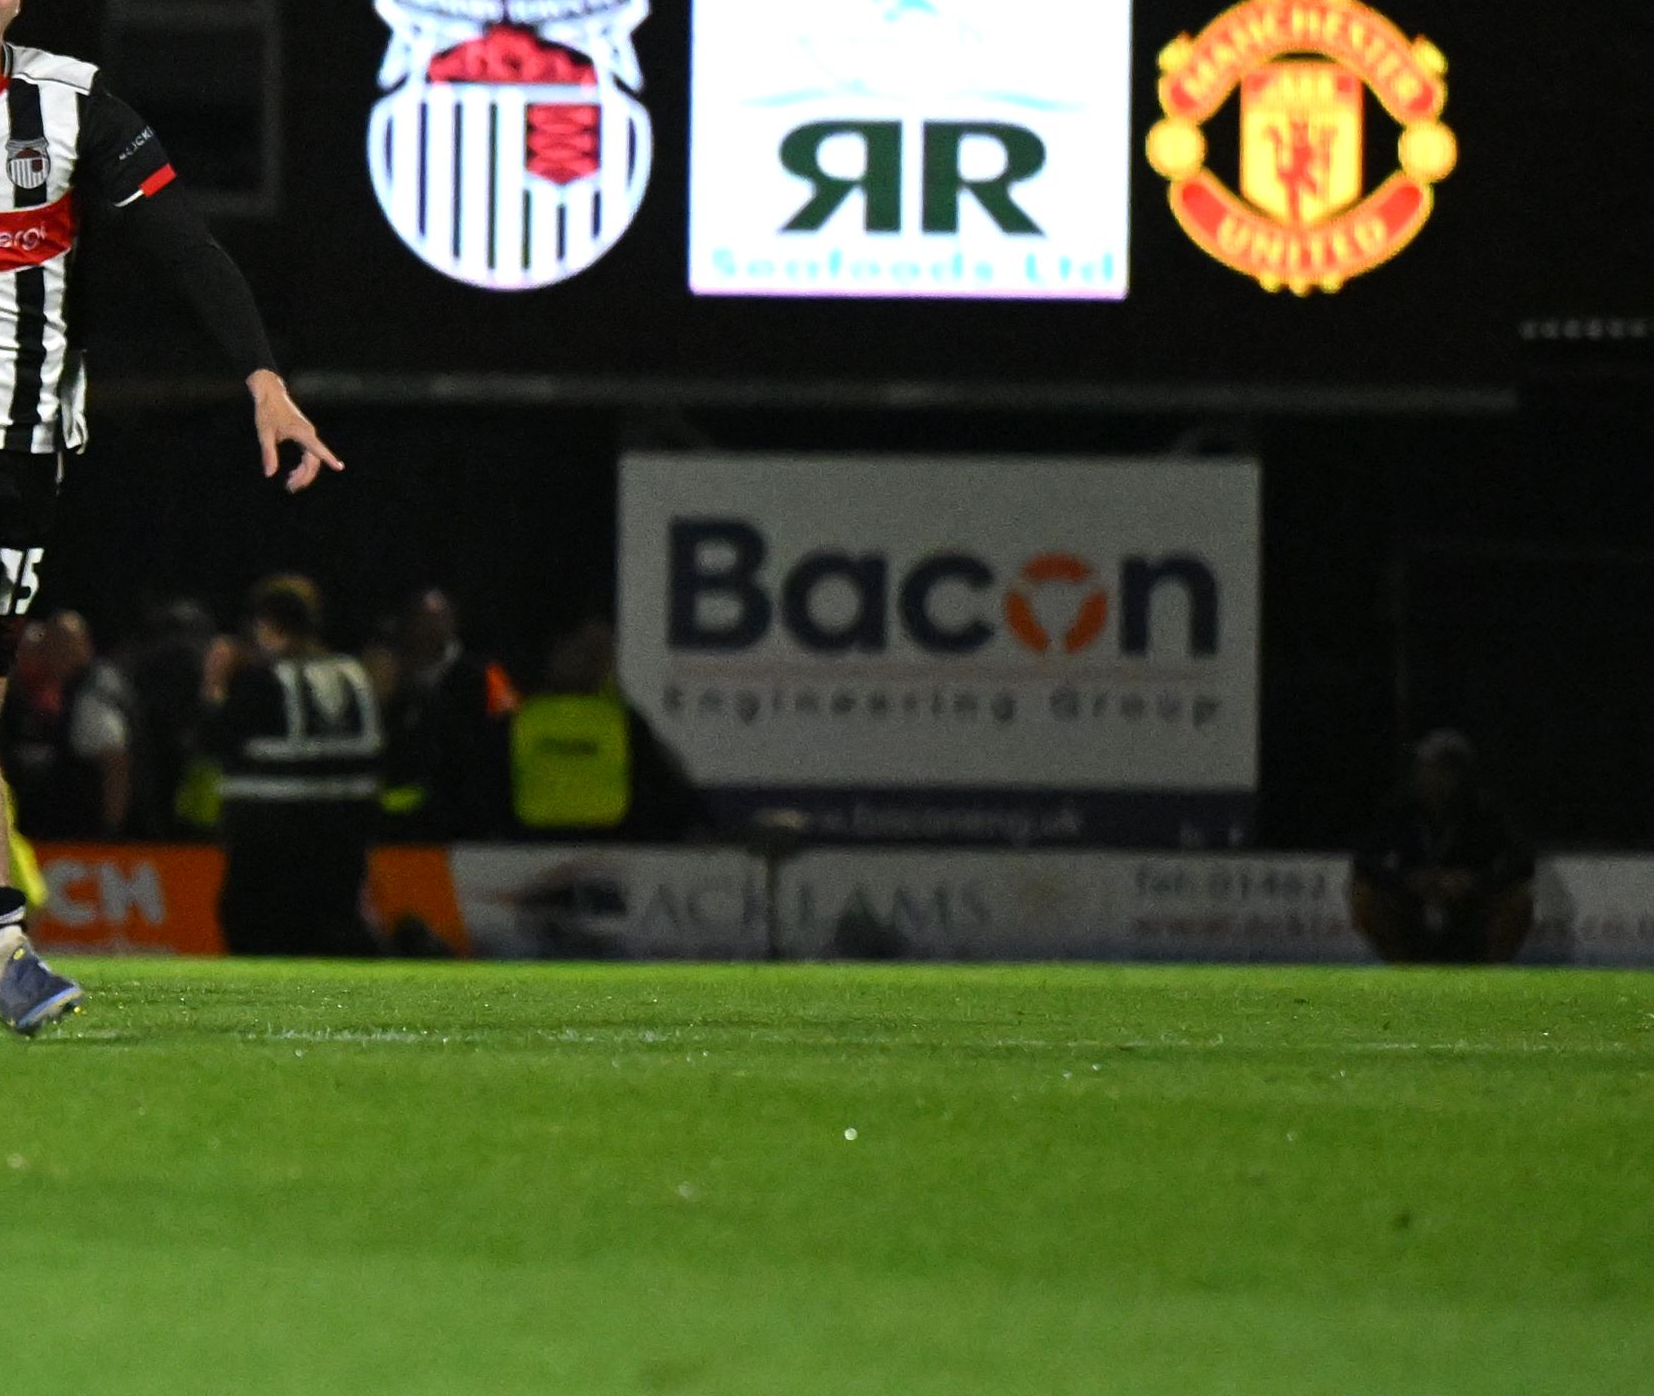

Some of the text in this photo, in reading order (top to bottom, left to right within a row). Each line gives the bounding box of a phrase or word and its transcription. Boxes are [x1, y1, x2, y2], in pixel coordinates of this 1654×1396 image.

[1183, 6, 1423, 107] MANCHESTER
[1217, 214, 1387, 265] UNITED
[666, 515, 1219, 657] Bacon
[1049, 684, 1223, 726] Group
